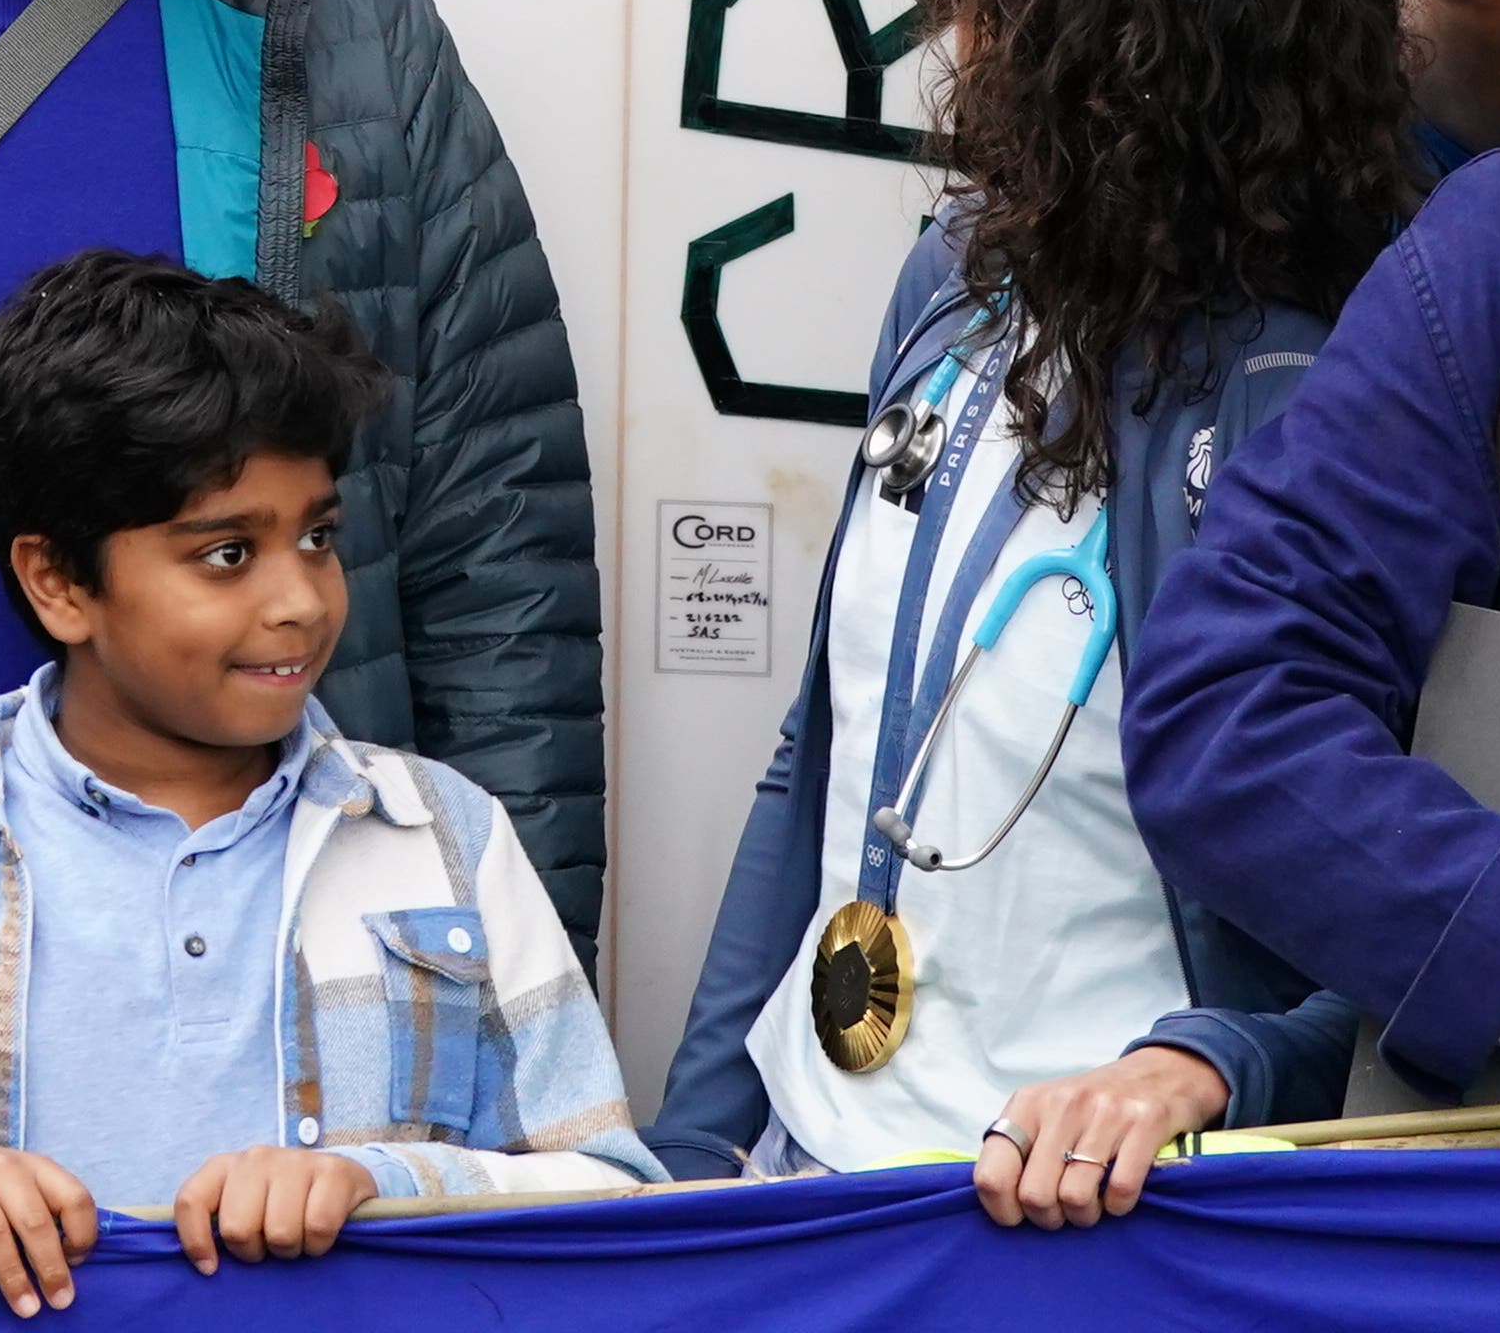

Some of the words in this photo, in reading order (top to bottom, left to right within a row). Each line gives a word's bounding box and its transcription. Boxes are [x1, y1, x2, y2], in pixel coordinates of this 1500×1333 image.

[938, 406, 979, 488] PARIS
[673, 515, 756, 549] CORD
[688, 625, 720, 640] SAS
